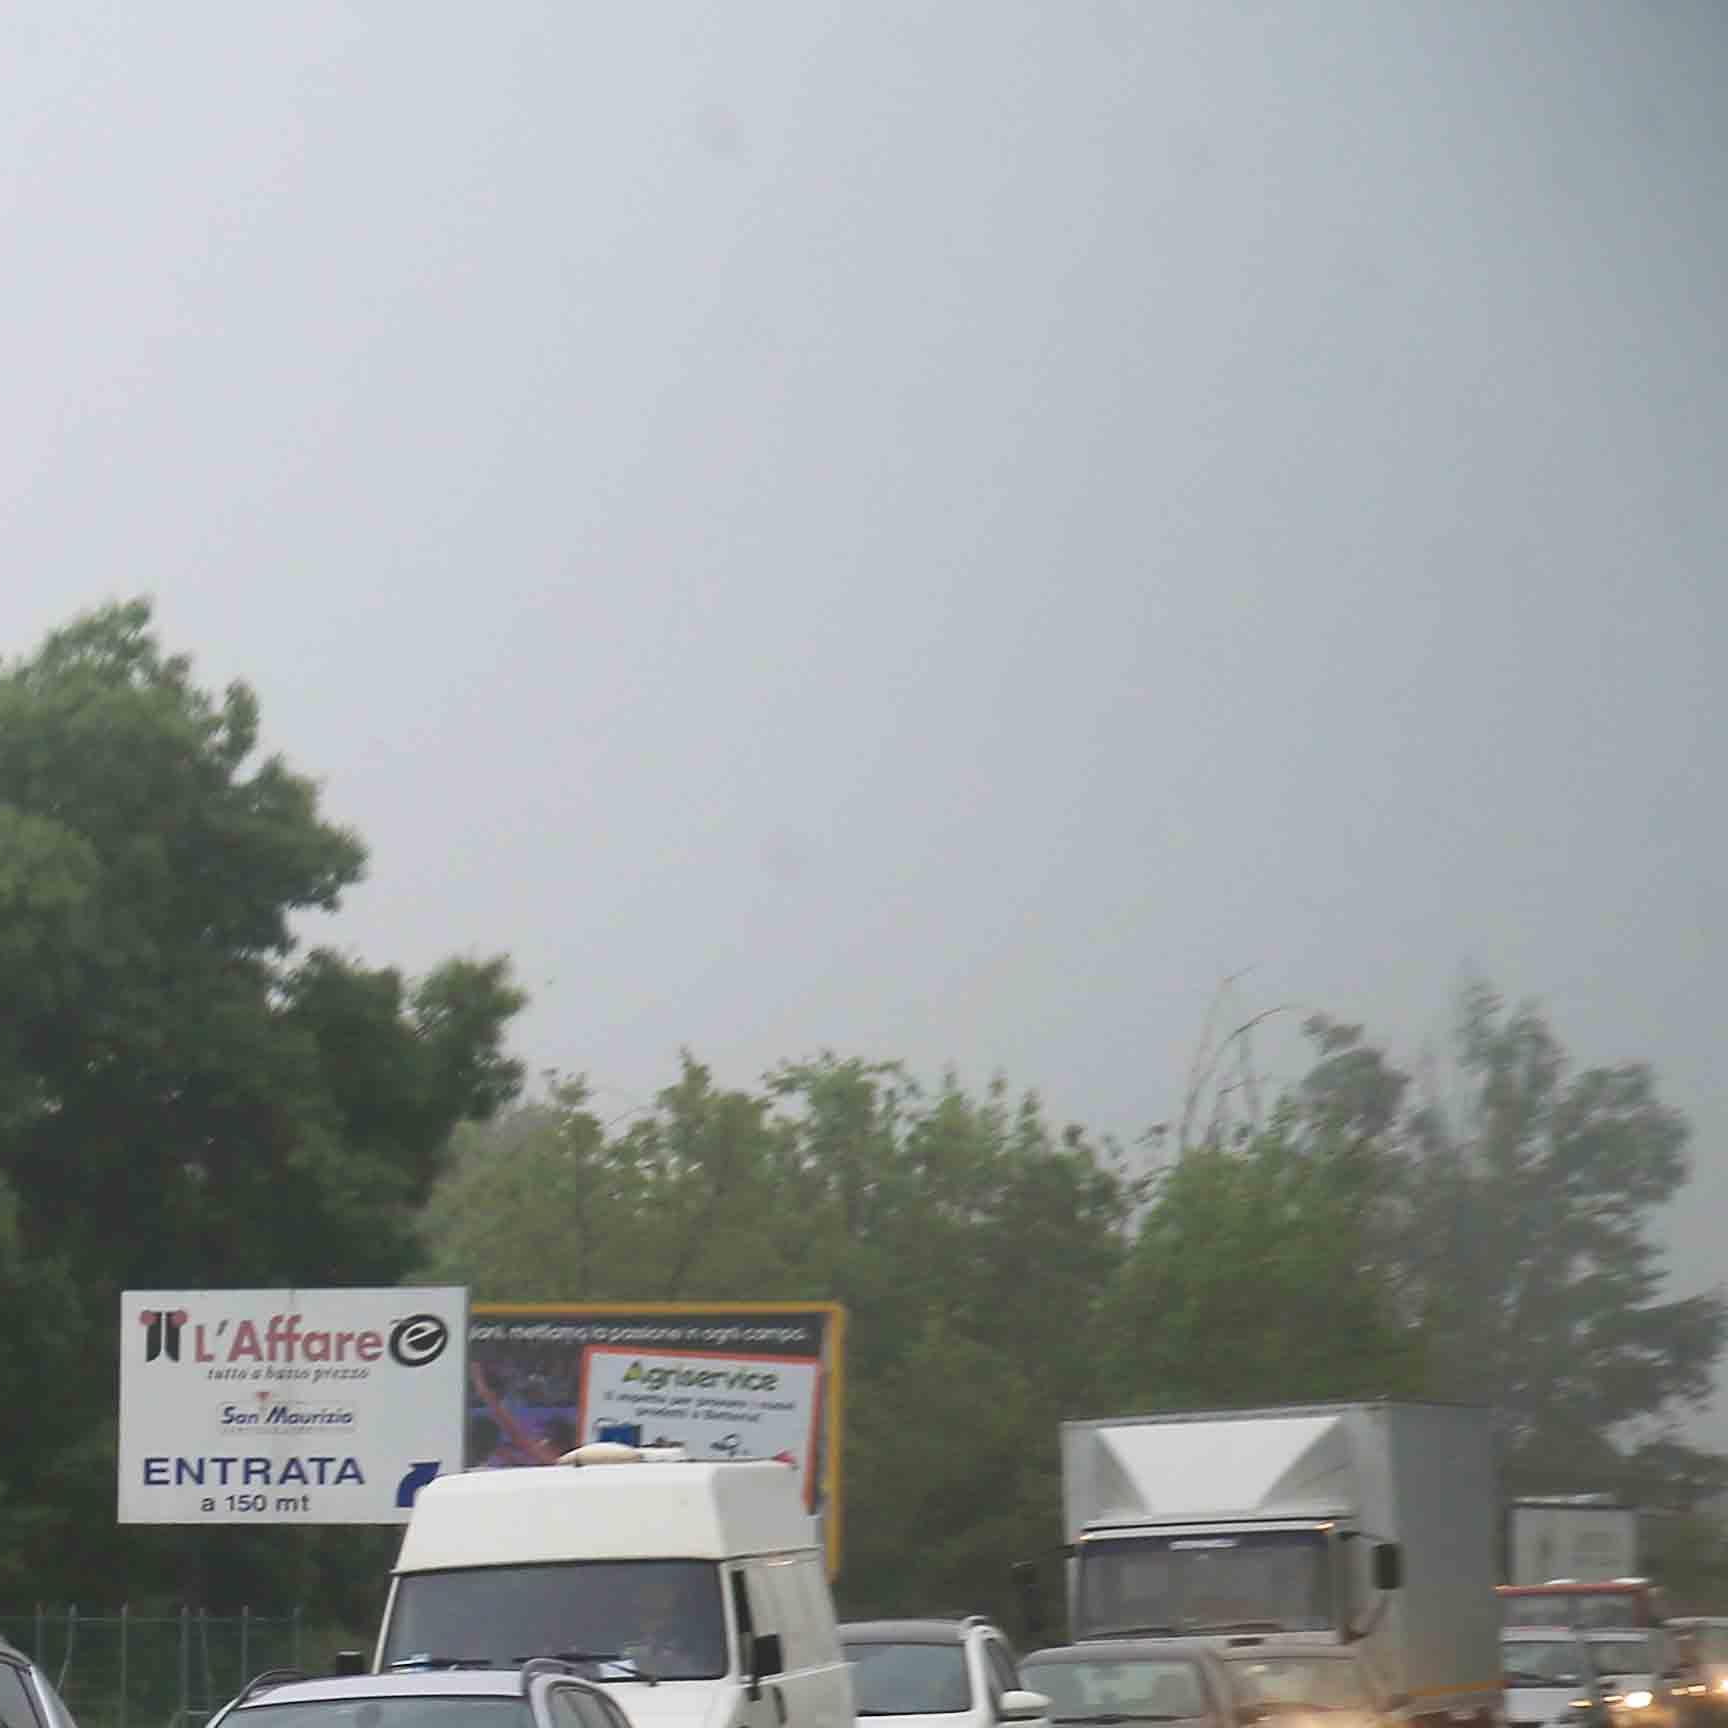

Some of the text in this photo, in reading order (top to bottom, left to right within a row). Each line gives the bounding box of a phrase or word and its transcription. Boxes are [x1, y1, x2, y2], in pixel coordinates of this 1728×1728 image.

[194, 1314, 384, 1364] L'Affare
[221, 1405, 354, 1425] San Maurizio
[143, 1457, 365, 1486] ENTRATA
[200, 1495, 310, 1512] a 150 mt
